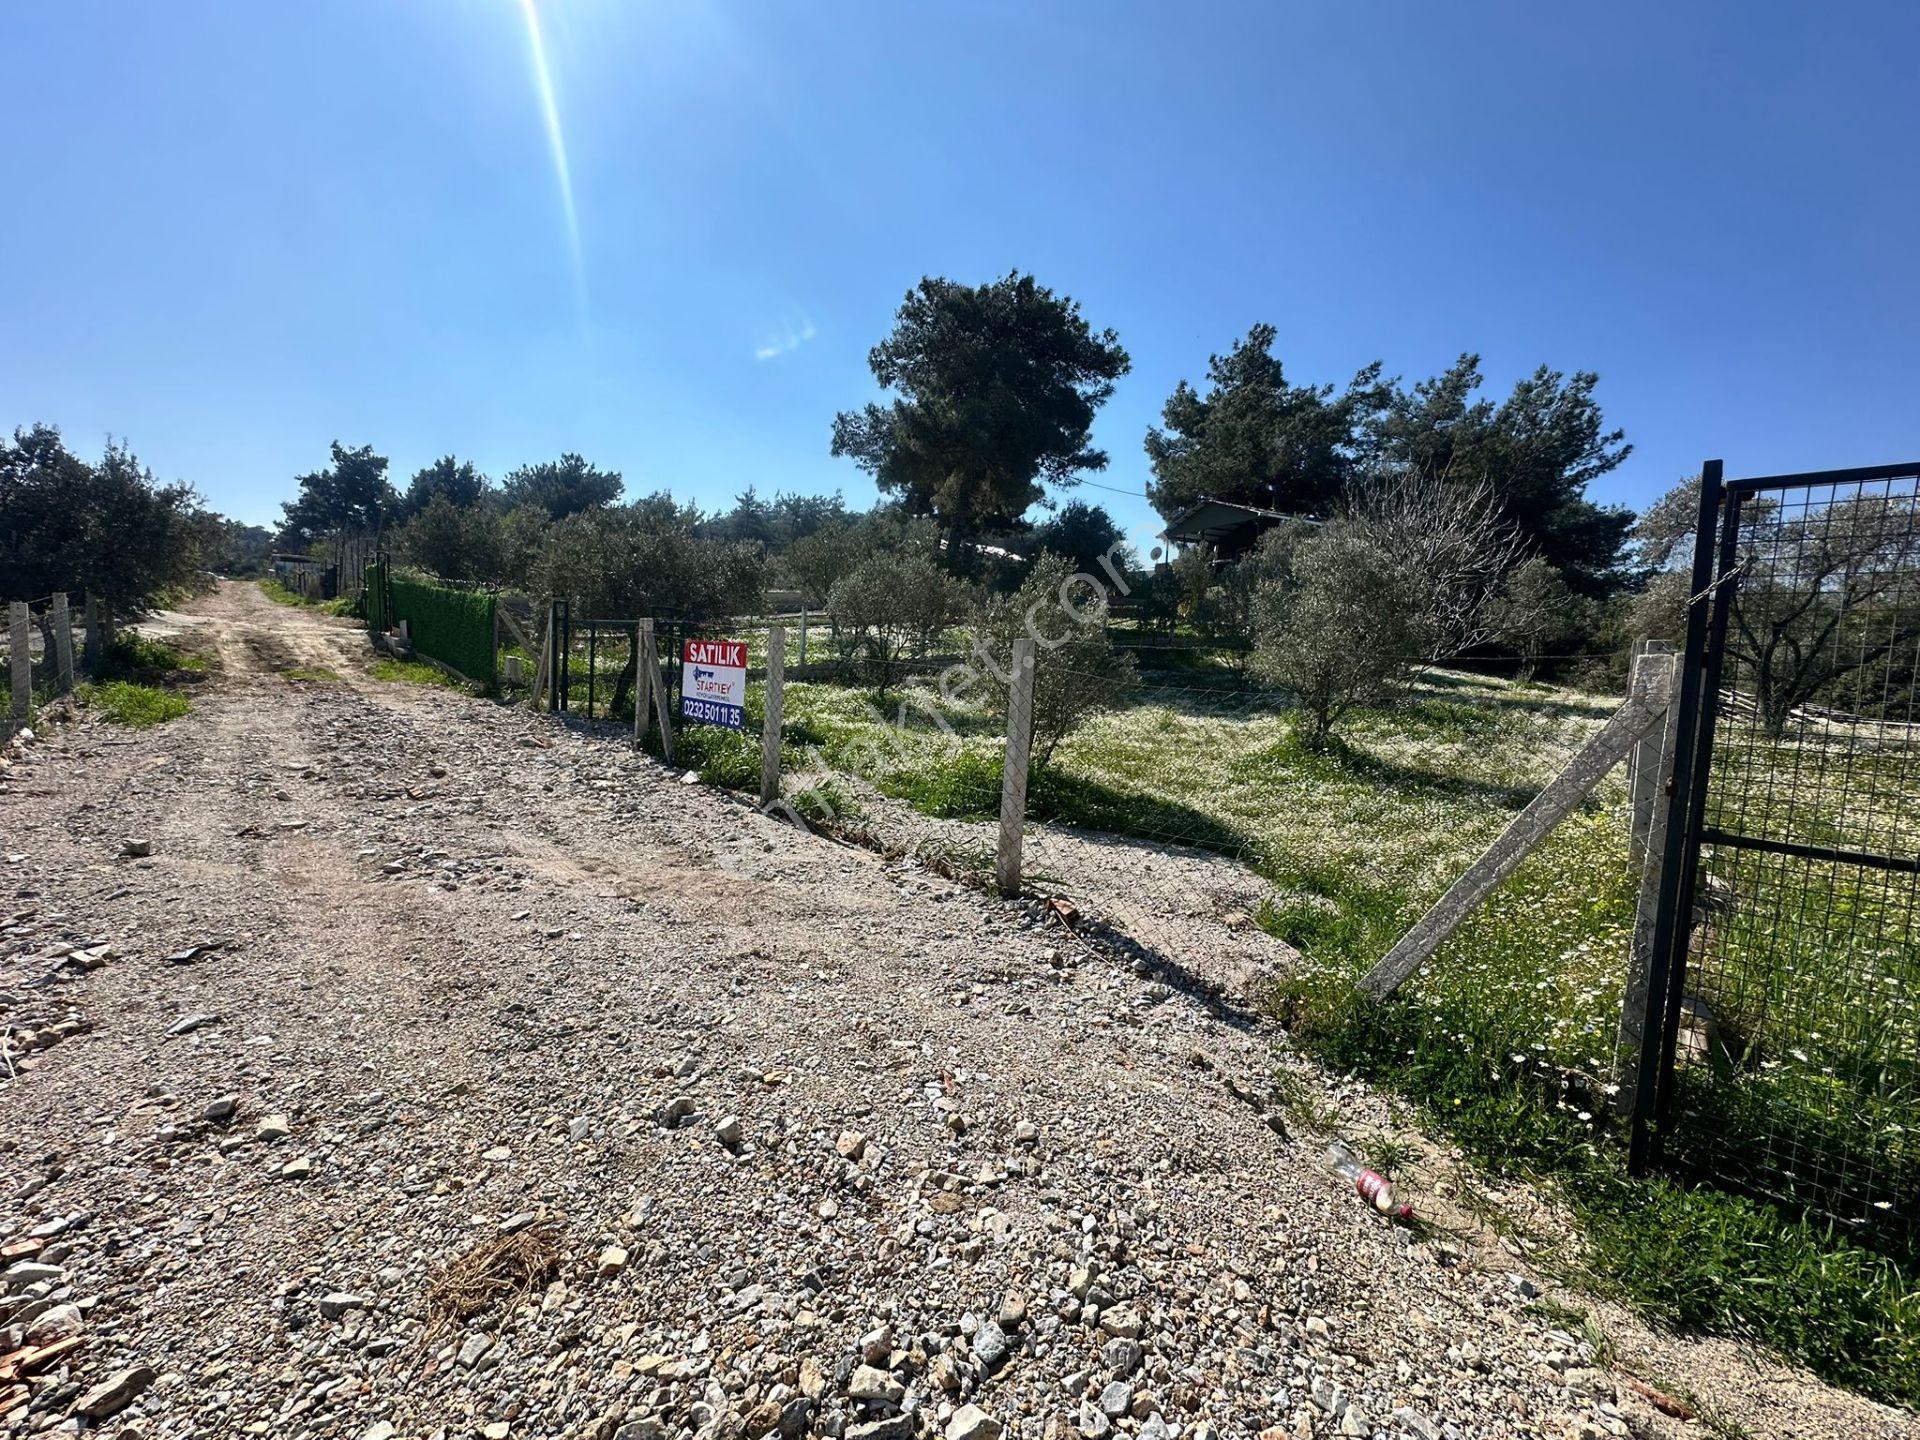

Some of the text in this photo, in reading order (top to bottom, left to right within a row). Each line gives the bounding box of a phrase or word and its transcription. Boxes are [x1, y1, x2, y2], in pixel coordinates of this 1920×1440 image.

[690, 643, 740, 665] SATILIK
[684, 700, 740, 725] 0232 501 11 35
